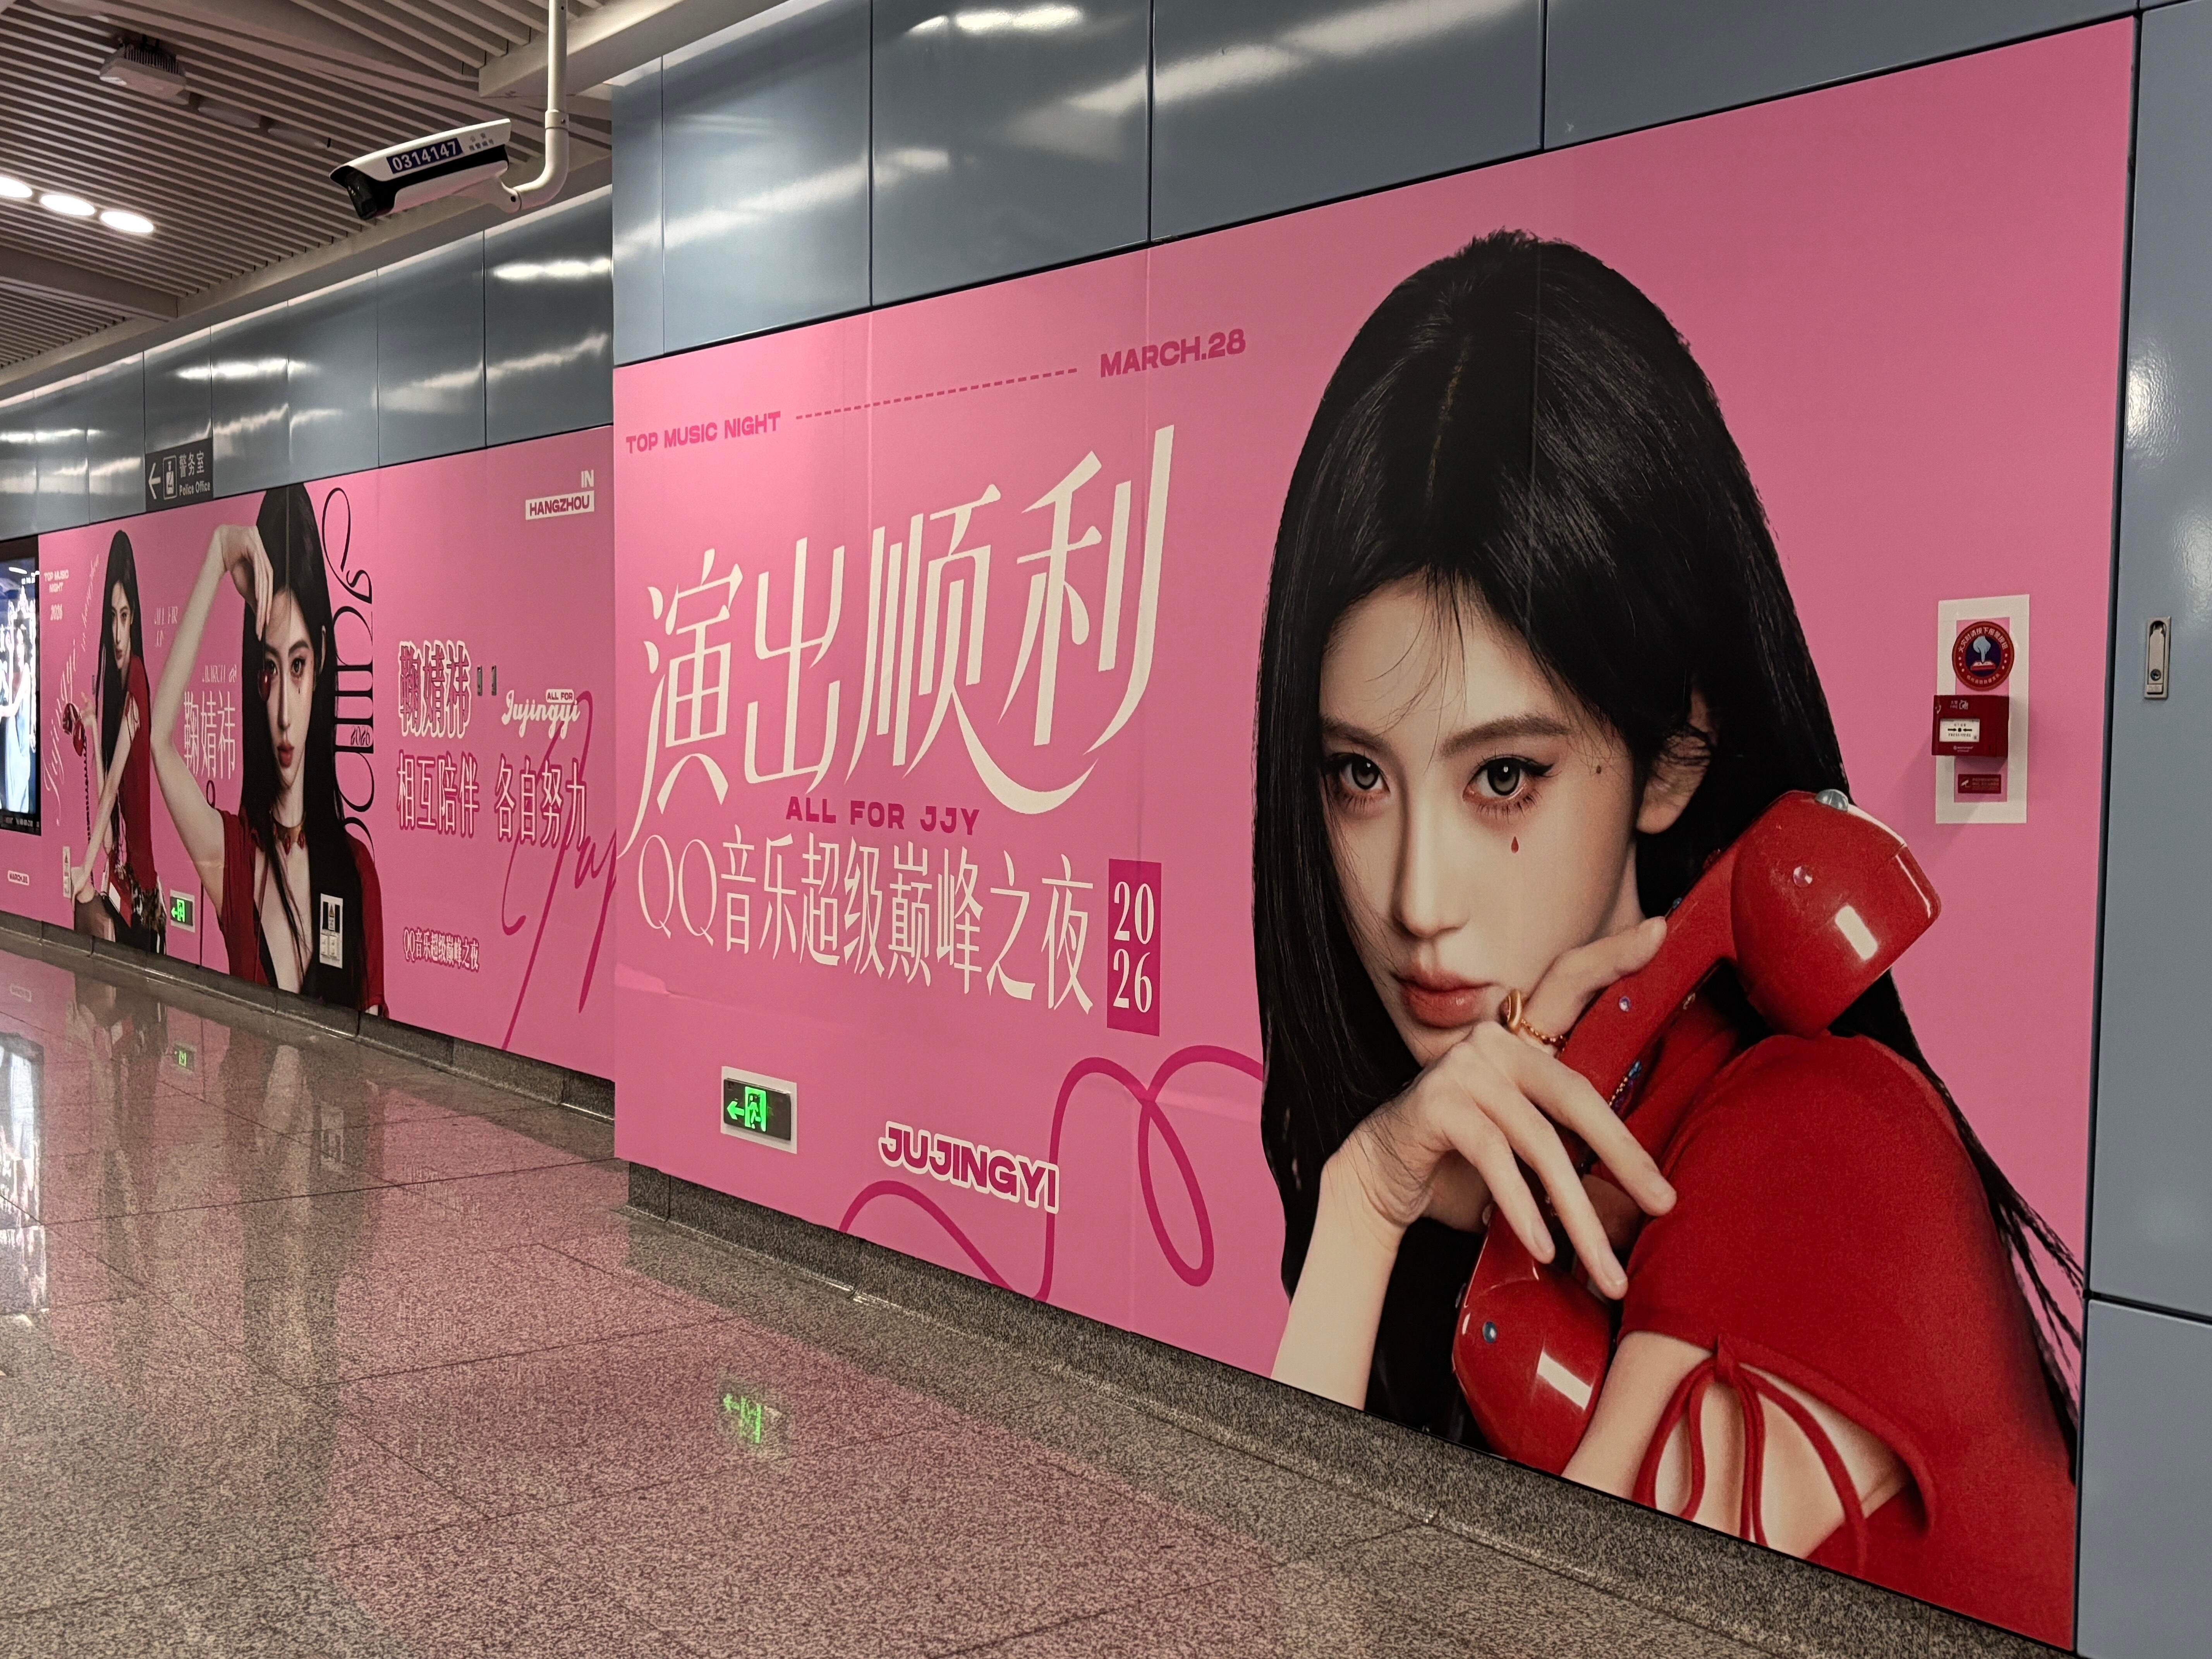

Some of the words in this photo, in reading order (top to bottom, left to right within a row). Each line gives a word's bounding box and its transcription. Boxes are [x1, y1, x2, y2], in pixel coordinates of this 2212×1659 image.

[392, 141, 456, 171] 0314147
[1101, 328, 1247, 378] MARCH.28
[625, 432, 658, 454] TOP
[664, 422, 718, 449] MUSIC
[724, 410, 781, 440] NIGHT
[179, 450, 205, 478] 警务室
[581, 469, 594, 488] IN
[179, 484, 194, 496] Police
[195, 480, 211, 493] Office
[529, 495, 590, 516] HANGZHOU
[618, 424, 1175, 857] 演出顺利
[547, 692, 559, 700] ALL
[561, 692, 573, 701] FOR
[397, 752, 479, 834] 相互陪伴
[496, 755, 585, 847] 各自努力
[785, 796, 836, 824] ALL
[850, 800, 905, 830] FOR
[920, 805, 980, 836] JJY
[637, 824, 1094, 1015] QQ音乐超级巅峰之夜
[1114, 881, 1154, 945] 20
[1113, 948, 1152, 1013] 26
[879, 1121, 1059, 1214] JUJINGYI
